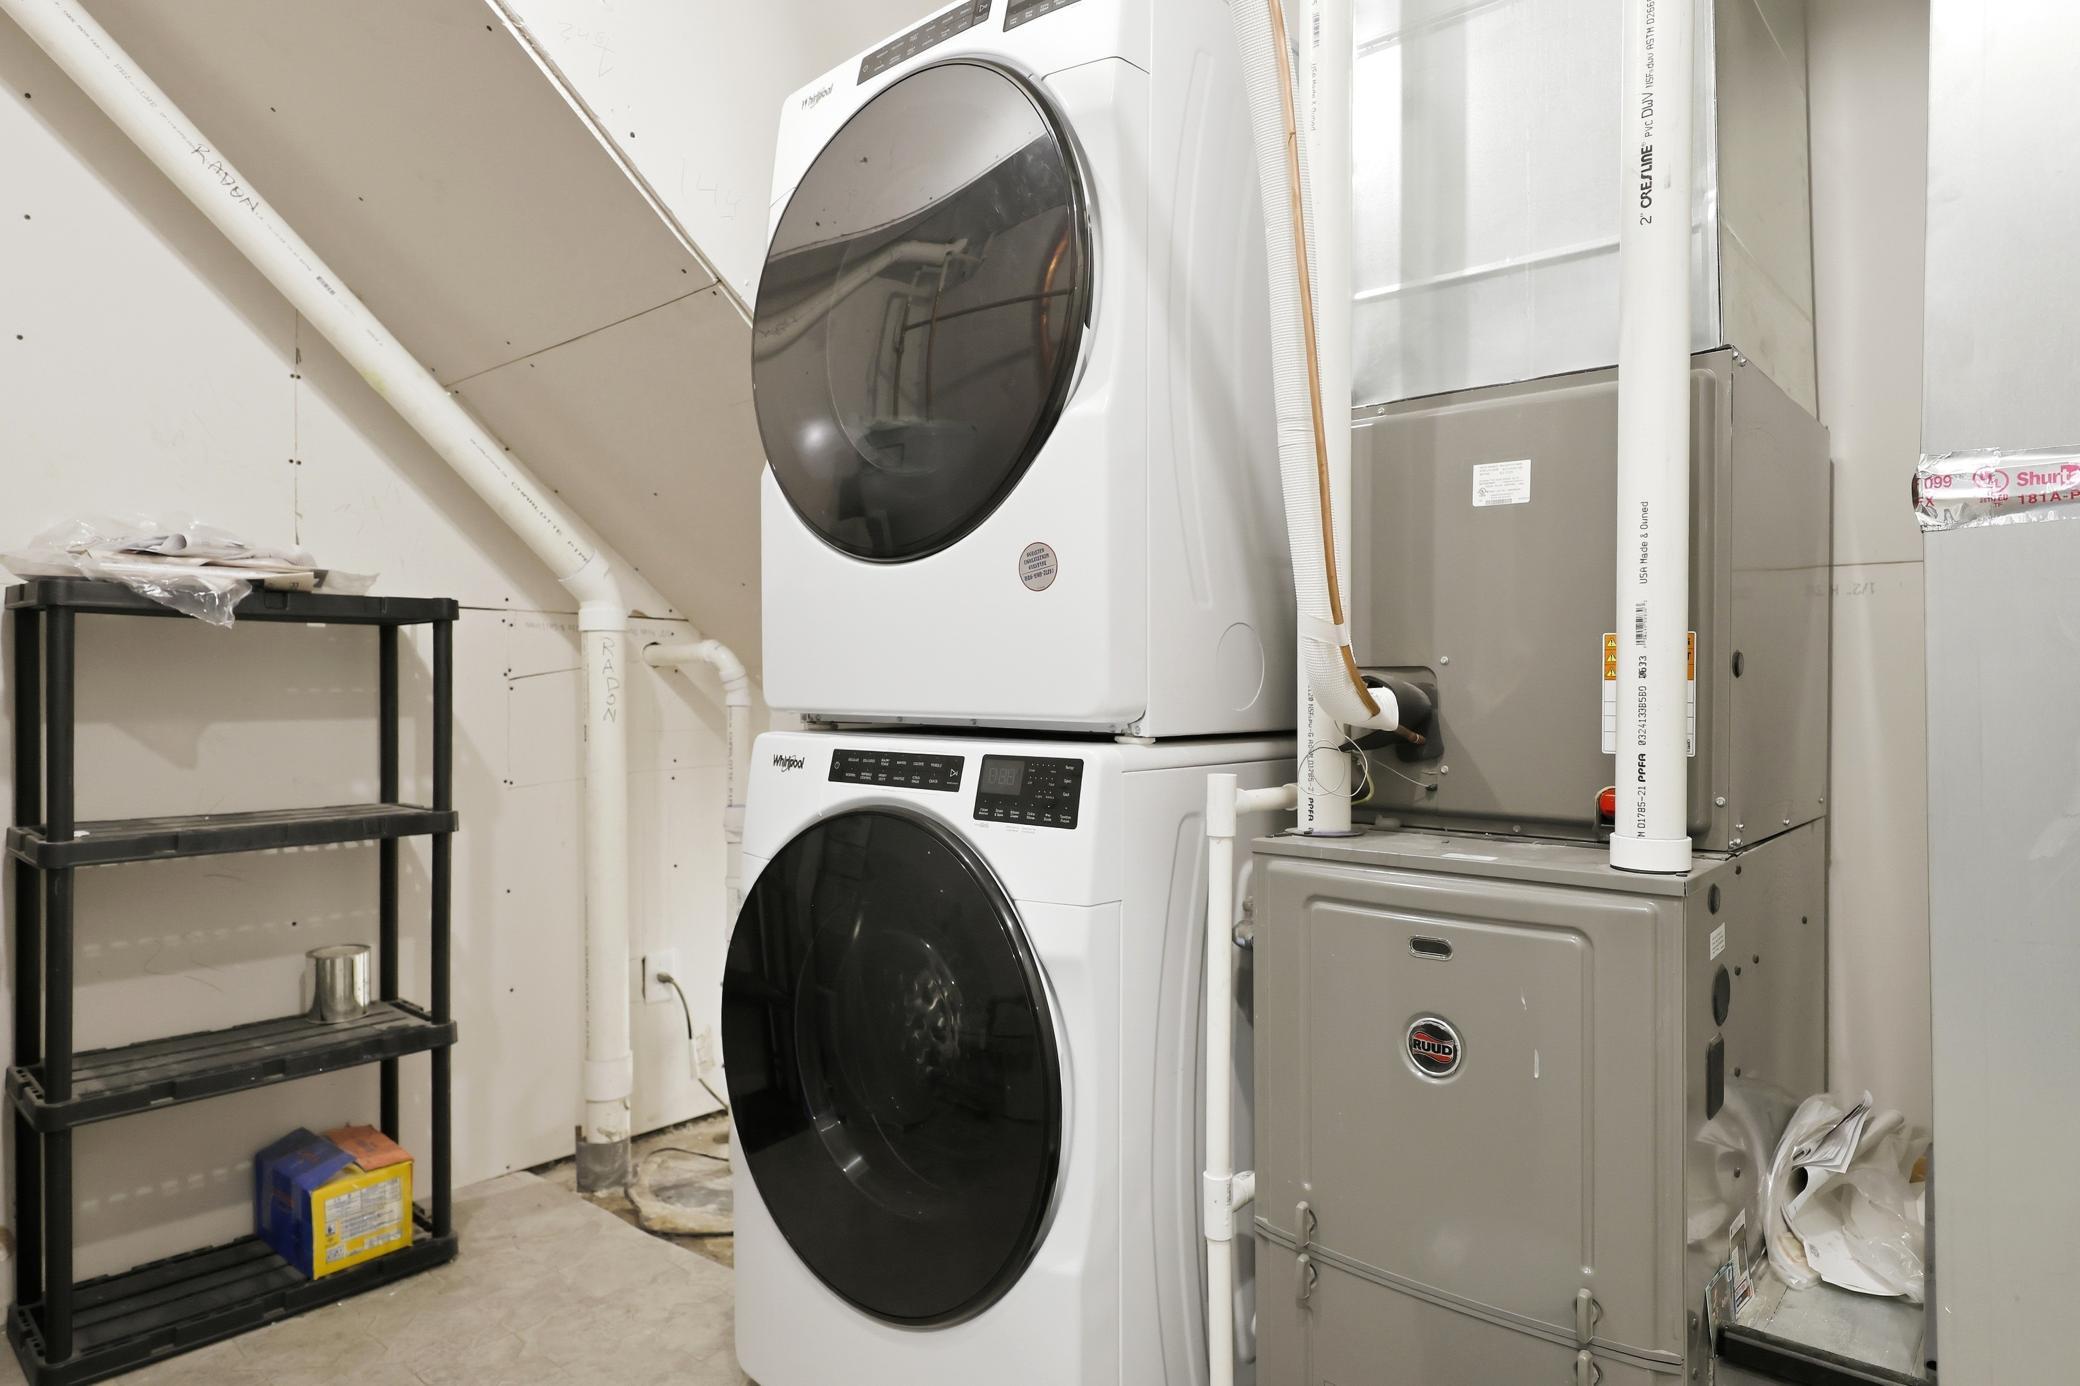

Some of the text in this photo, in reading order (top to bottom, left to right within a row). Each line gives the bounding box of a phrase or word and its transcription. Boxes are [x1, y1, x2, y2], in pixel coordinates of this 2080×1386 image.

[1645, 26, 1655, 50] ASTM
[1641, 92, 1654, 119] DWV
[1644, 119, 1654, 138] PVC
[191, 143, 260, 213] RADON
[1639, 501, 1648, 530] Owned
[1639, 541, 1648, 564] Made
[1639, 566, 1648, 584] USA
[773, 754, 805, 772] Whirlpool
[1637, 753, 1647, 783] PPFA
[1307, 797, 1315, 822] PPFA
[1413, 1039, 1453, 1056] RUUD
